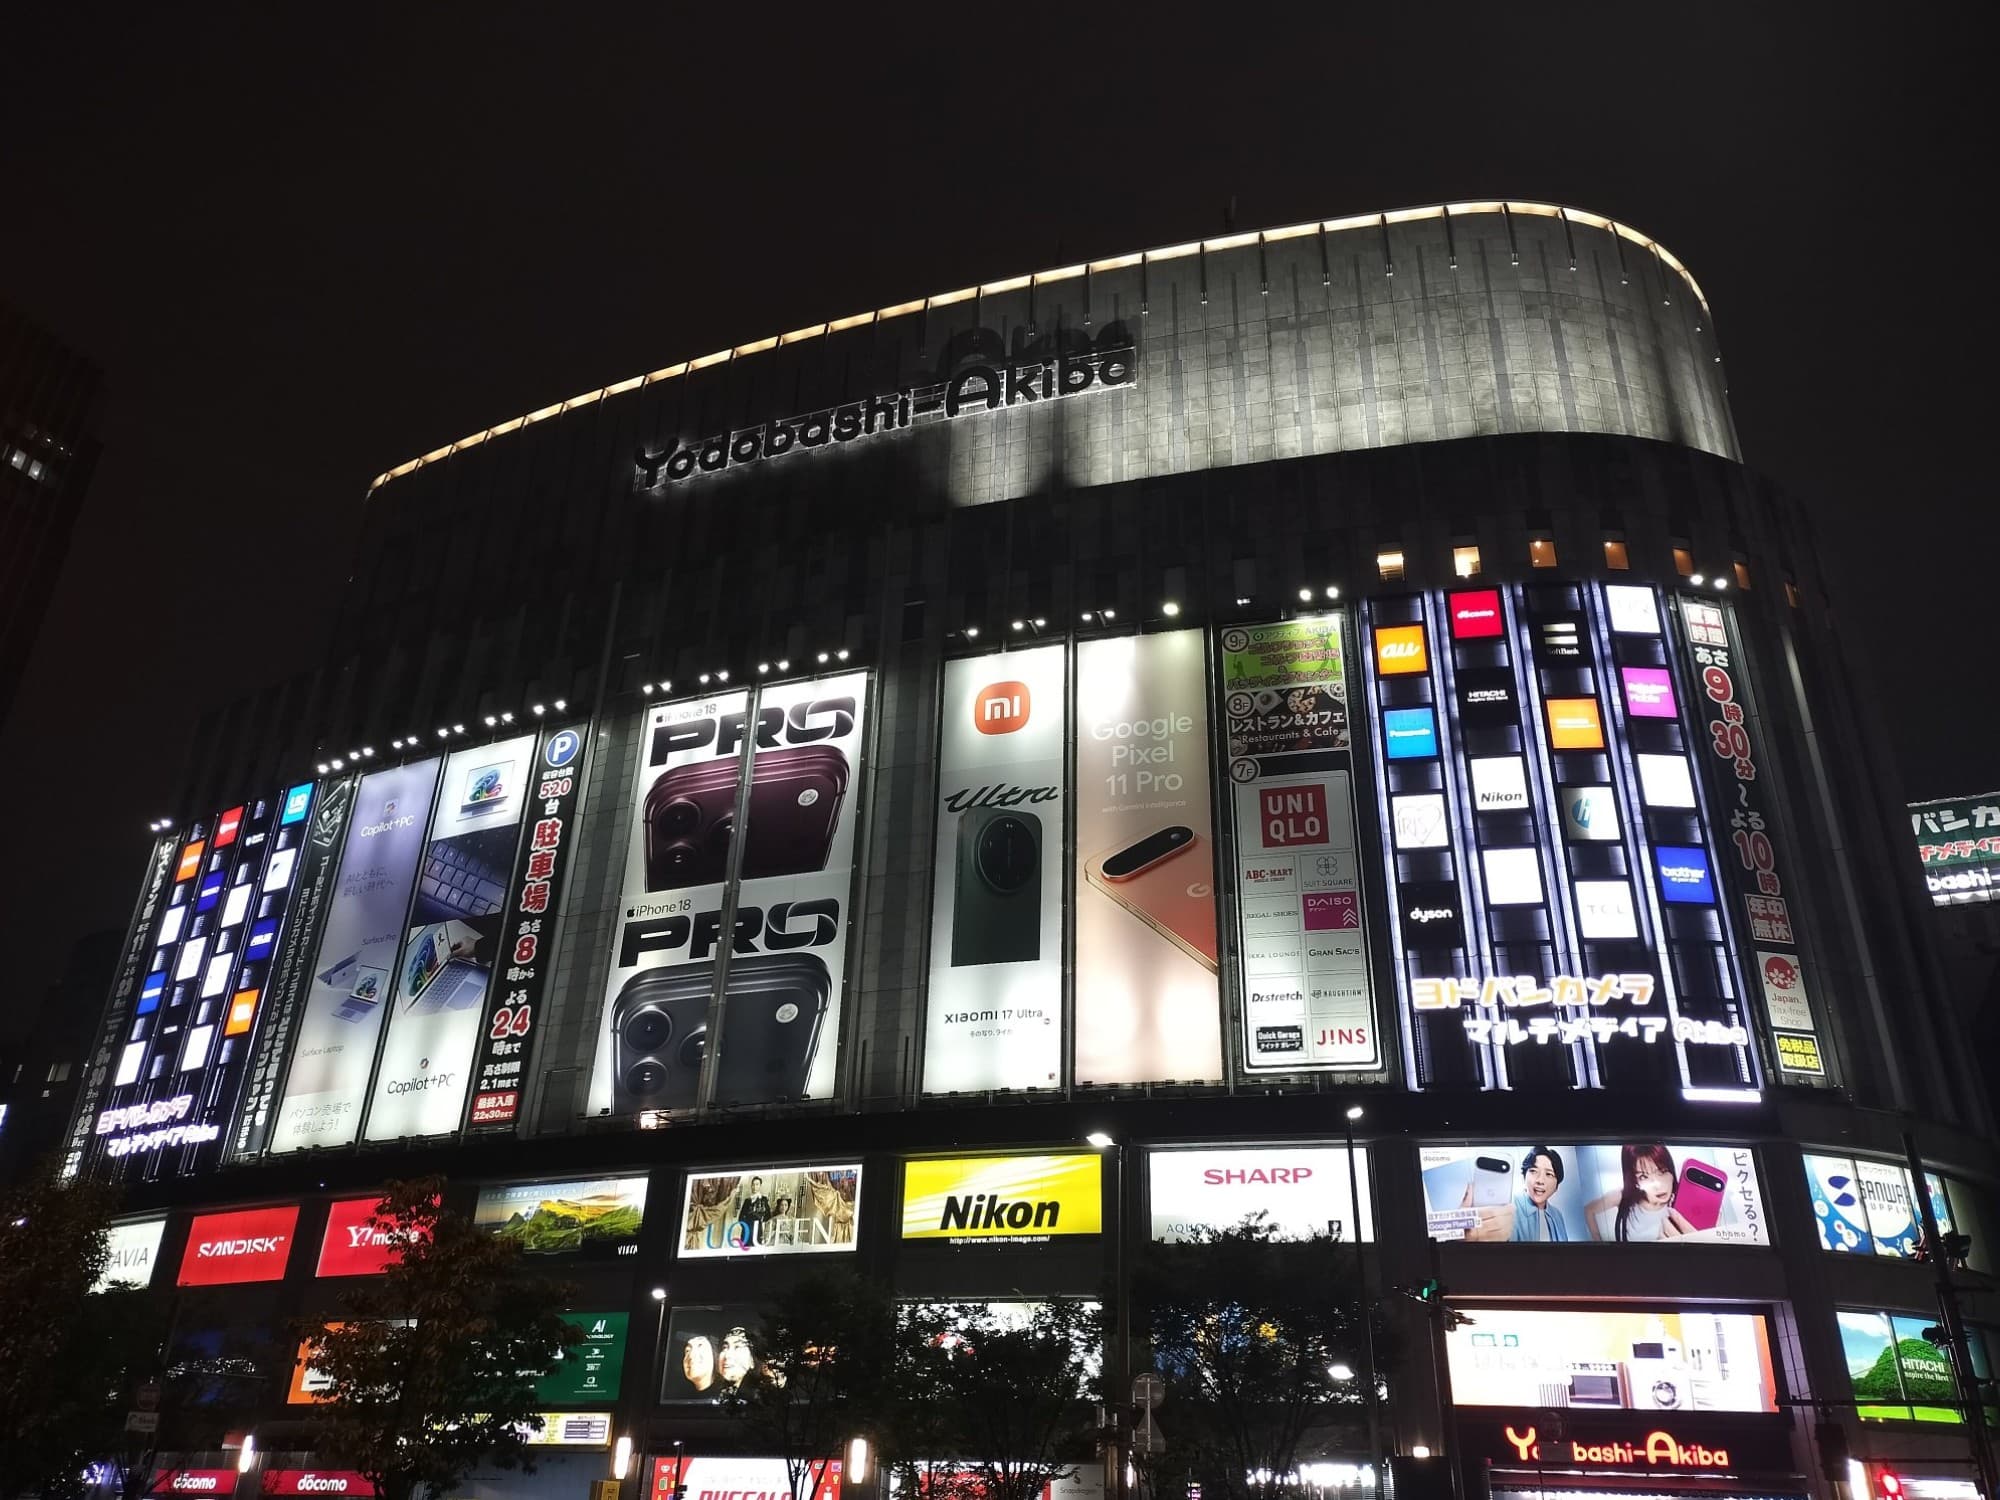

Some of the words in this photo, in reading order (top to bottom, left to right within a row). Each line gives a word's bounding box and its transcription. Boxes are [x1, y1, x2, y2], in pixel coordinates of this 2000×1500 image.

[636, 354, 1136, 489] Yodobashi-Akiba
[1380, 641, 1421, 659] au
[1549, 647, 1580, 655] oftBank
[1695, 647, 1729, 667] あさ
[703, 703, 717, 715] 18
[649, 696, 856, 767] PRO
[1091, 711, 1193, 741] Google
[1242, 731, 1300, 744] Restaurants
[1303, 728, 1311, 738] &
[1314, 726, 1340, 737] Cafe
[1111, 740, 1175, 768] Pixel
[1236, 763, 1254, 778] 7F
[538, 778, 573, 799] 520
[1105, 773, 1128, 797] 11
[1136, 770, 1183, 793] Pro
[943, 783, 1059, 813] Ultra
[1267, 792, 1314, 815] UNI
[1481, 791, 1523, 803] Nikon
[543, 799, 561, 815] 台
[1270, 817, 1321, 843] QLO
[520, 819, 562, 914] 駐車場
[635, 903, 677, 918] iPhone
[678, 899, 692, 912] 18
[1307, 896, 1352, 907] DAISO
[1410, 906, 1453, 922] dyson
[519, 919, 542, 934] あさ
[618, 898, 840, 969] PRO
[514, 934, 538, 964] 8
[1308, 948, 1334, 957] GRAN
[507, 967, 536, 982] 時から
[504, 989, 528, 1005] よる
[1411, 973, 1654, 1010] ヨドバシカメラ
[490, 1004, 532, 1039] 24
[944, 1010, 998, 1025] xiaomi
[1001, 1009, 1013, 1020] 17
[1016, 1008, 1043, 1019] Ultra
[492, 1041, 522, 1056] 時まで
[1203, 1167, 1312, 1185] SHARP
[940, 1194, 1061, 1231] Nikon
[1870, 1202, 1908, 1215] UPPLY
[592, 1319, 606, 1333] AI
[1901, 1357, 1946, 1374] HITACHI
[1903, 1371, 1923, 1380] nspire
[1923, 1372, 1934, 1380] the
[1505, 1426, 1730, 1467] Ybashi-Akiba
[173, 1474, 217, 1490] docomo
[297, 1474, 348, 1491] docomo
